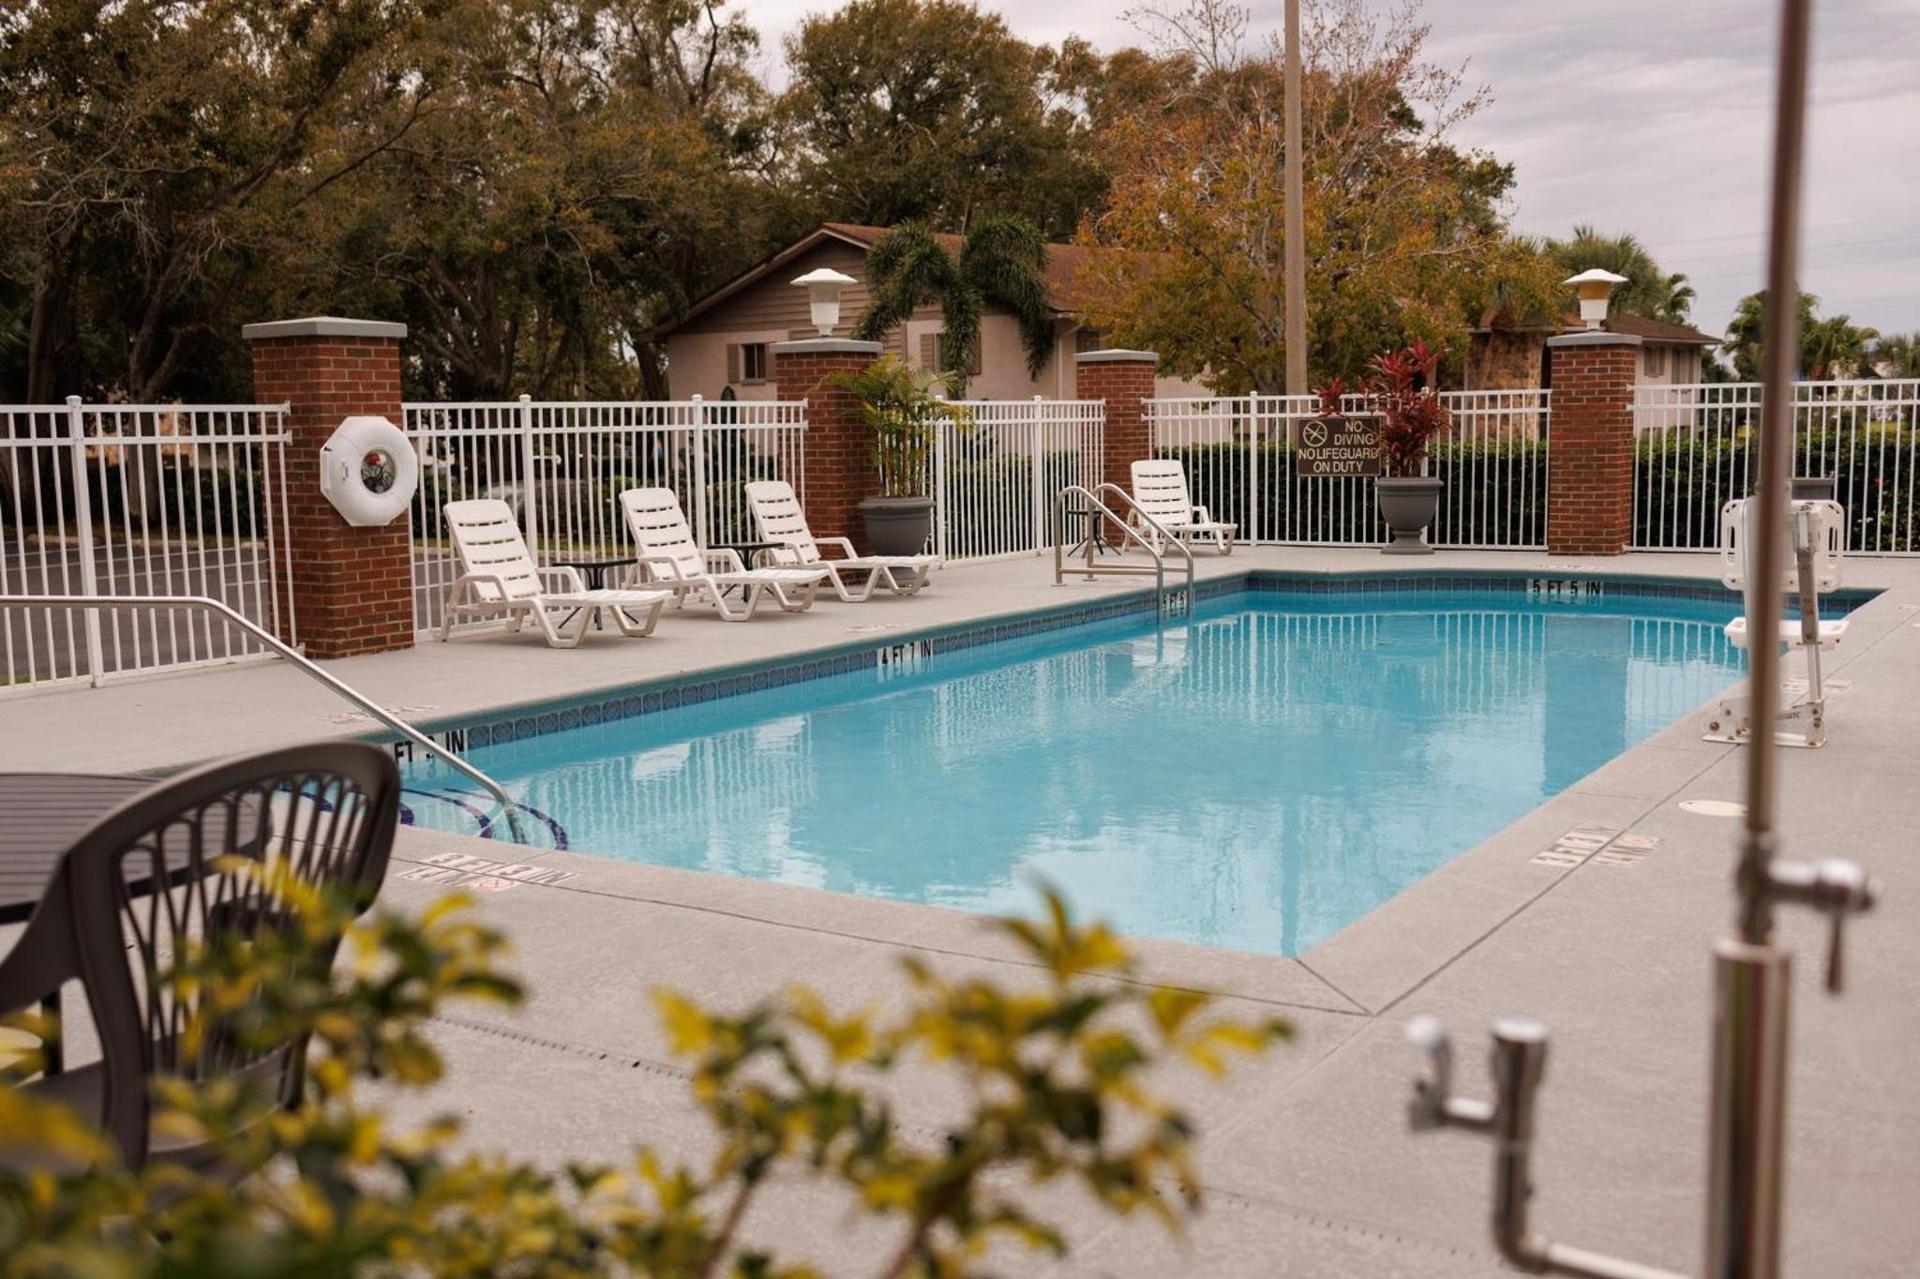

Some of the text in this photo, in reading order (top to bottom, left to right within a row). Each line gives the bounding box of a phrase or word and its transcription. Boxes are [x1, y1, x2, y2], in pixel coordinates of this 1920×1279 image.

[1345, 421, 1363, 432] NO
[1334, 434, 1374, 445] DIVING
[1299, 448, 1379, 460] NO LIFEGUARD
[1313, 461, 1364, 472] ON DUTY
[1533, 580, 1600, 594] 5 FT 5 IN
[881, 648, 888, 664] 4
[893, 645, 904, 663] FT
[920, 640, 931, 656] IN
[394, 741, 413, 763] FT
[446, 730, 464, 753] IN
